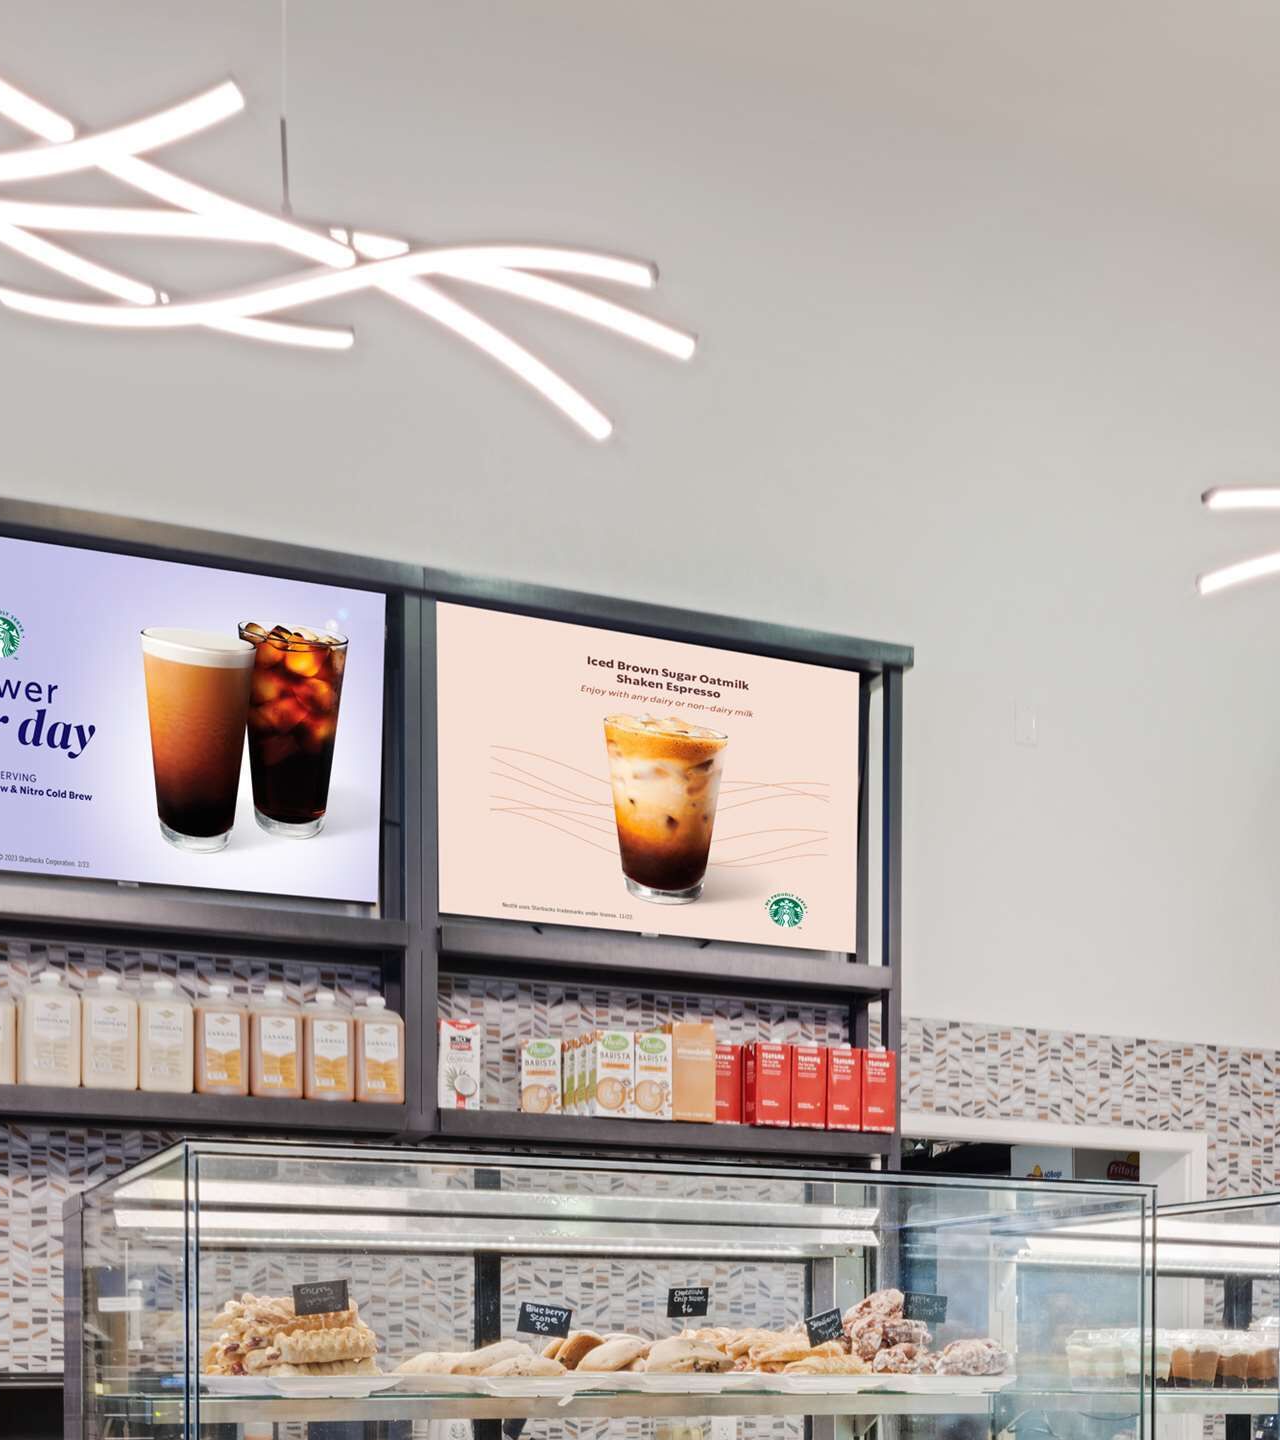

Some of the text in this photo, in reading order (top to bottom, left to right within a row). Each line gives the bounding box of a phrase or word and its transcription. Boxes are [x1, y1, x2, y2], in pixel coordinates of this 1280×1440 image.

[587, 656, 749, 691] Iced Brown Sugar Oatmilk
[616, 674, 721, 699] Shaken Espresso
[580, 684, 607, 697] Enjoy
[608, 689, 630, 699] with
[631, 693, 648, 703] any
[650, 695, 673, 707] dairy
[687, 702, 734, 716] non-dairy
[735, 709, 753, 718] milk
[17, 708, 96, 759] day
[10, 784, 18, 794] &
[19, 785, 44, 797] Nitro
[46, 788, 67, 799] Cold
[69, 791, 93, 801] Brew
[5, 854, 18, 862] 2023
[19, 855, 44, 865] Starbucks
[600, 1052, 631, 1060] BARISTA
[638, 1055, 668, 1063] BARISTA
[681, 1304, 693, 1313] $6
[535, 1321, 549, 1331] $6
